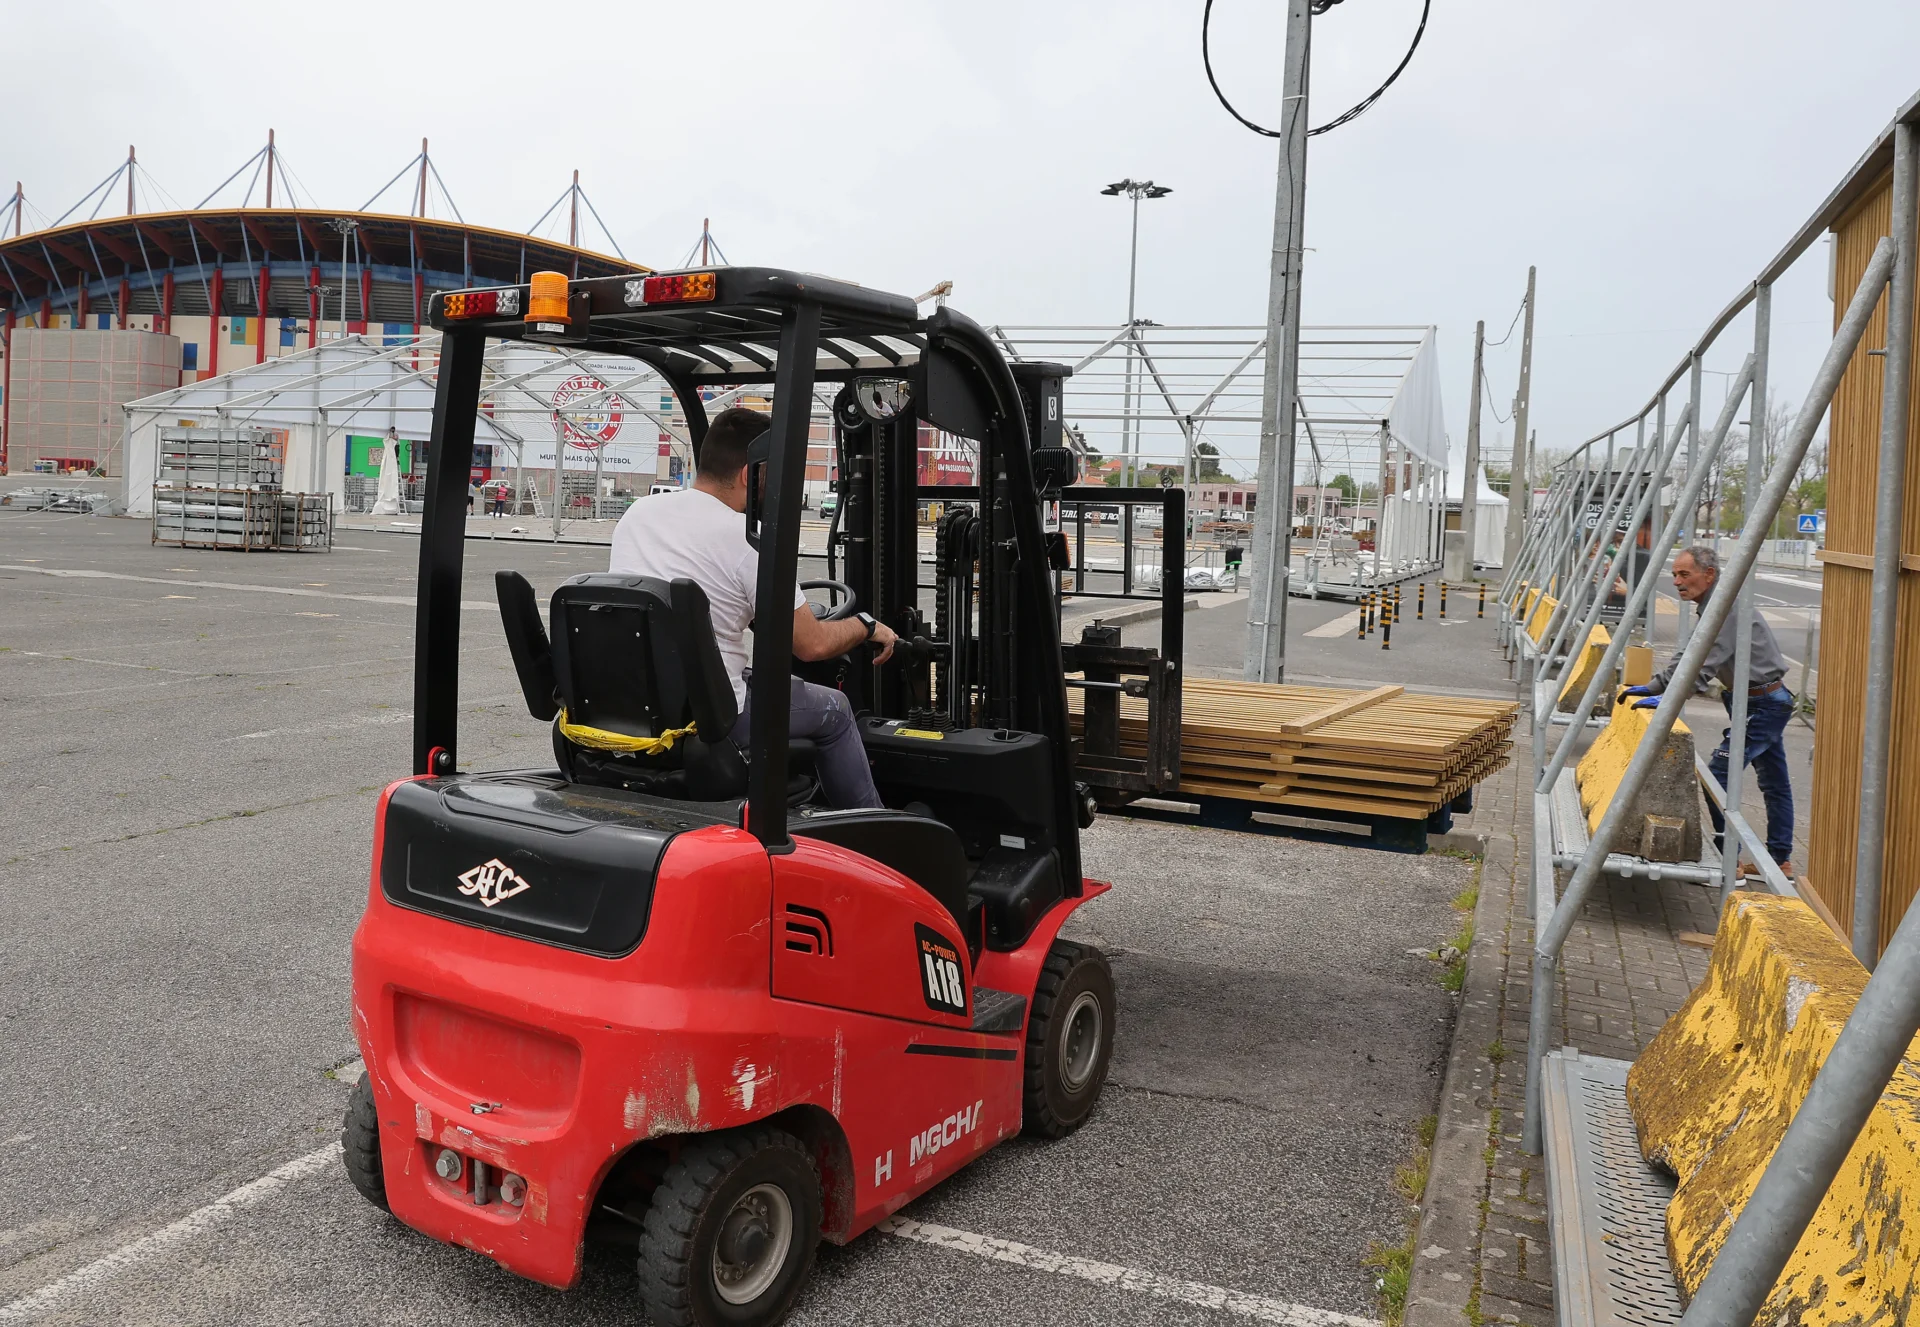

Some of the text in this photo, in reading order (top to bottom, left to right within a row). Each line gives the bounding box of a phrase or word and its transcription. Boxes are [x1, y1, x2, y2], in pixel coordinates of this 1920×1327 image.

[581, 377, 594, 387] DE
[921, 940, 957, 962] AC-POWER
[924, 953, 965, 1008] A18
